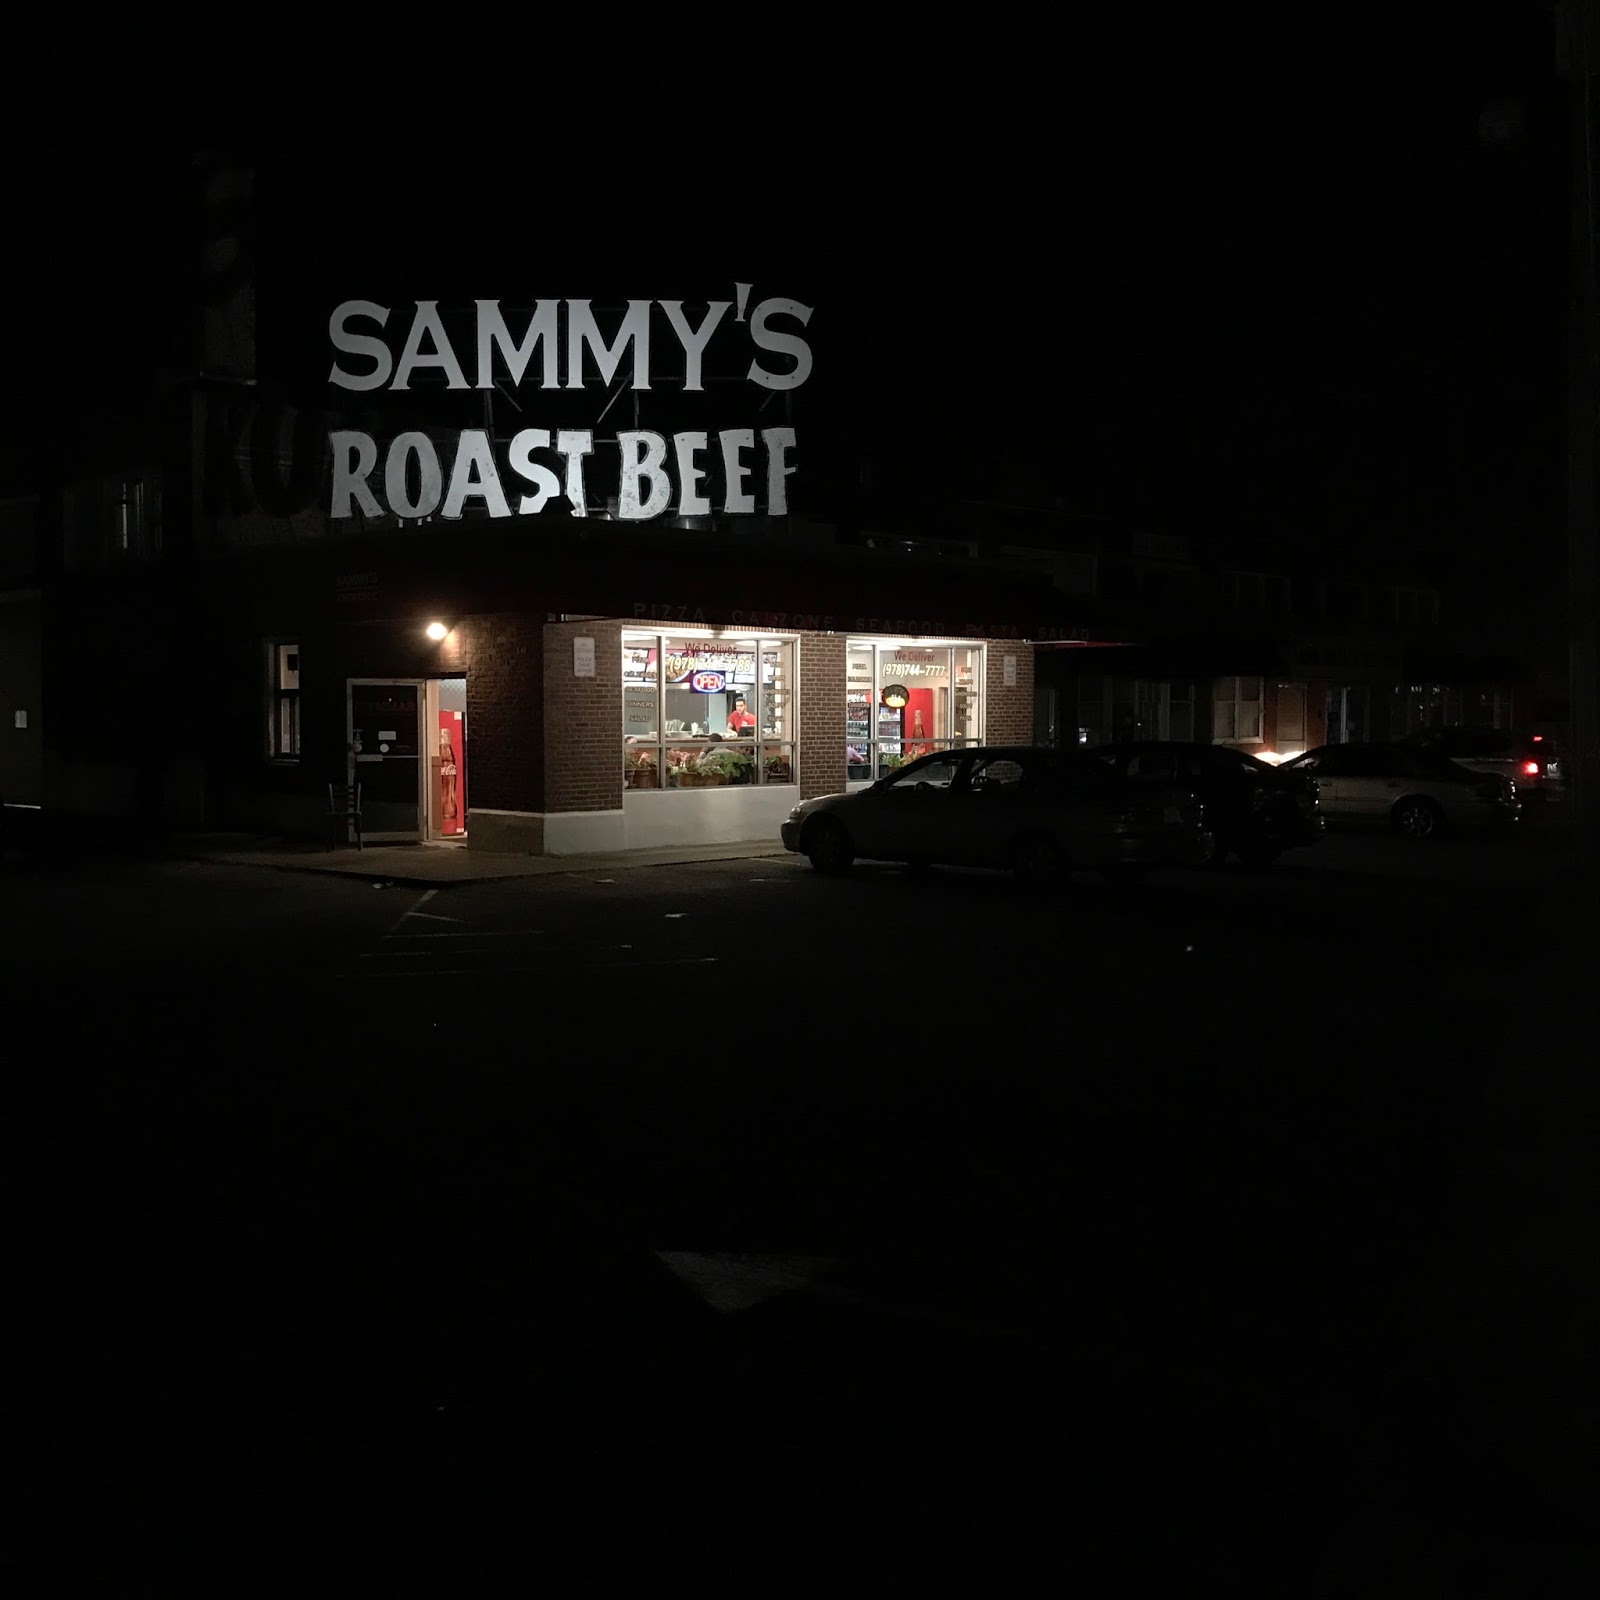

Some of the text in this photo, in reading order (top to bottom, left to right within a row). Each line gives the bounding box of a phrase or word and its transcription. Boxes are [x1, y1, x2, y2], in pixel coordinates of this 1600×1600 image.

[328, 282, 814, 392] SAMMY'S
[328, 427, 594, 521] ROAST
[616, 426, 798, 521] BEEF
[632, 602, 1090, 640] PIZZA CALZONE SEAFOOD PASTA SALAD
[684, 642, 738, 654] We Deliver
[894, 650, 935, 662] We Deliver
[882, 663, 946, 678] (978)744-7777
[695, 675, 723, 689] OPEN
[626, 700, 655, 708] DINNERS
[629, 715, 652, 723] SALAD
